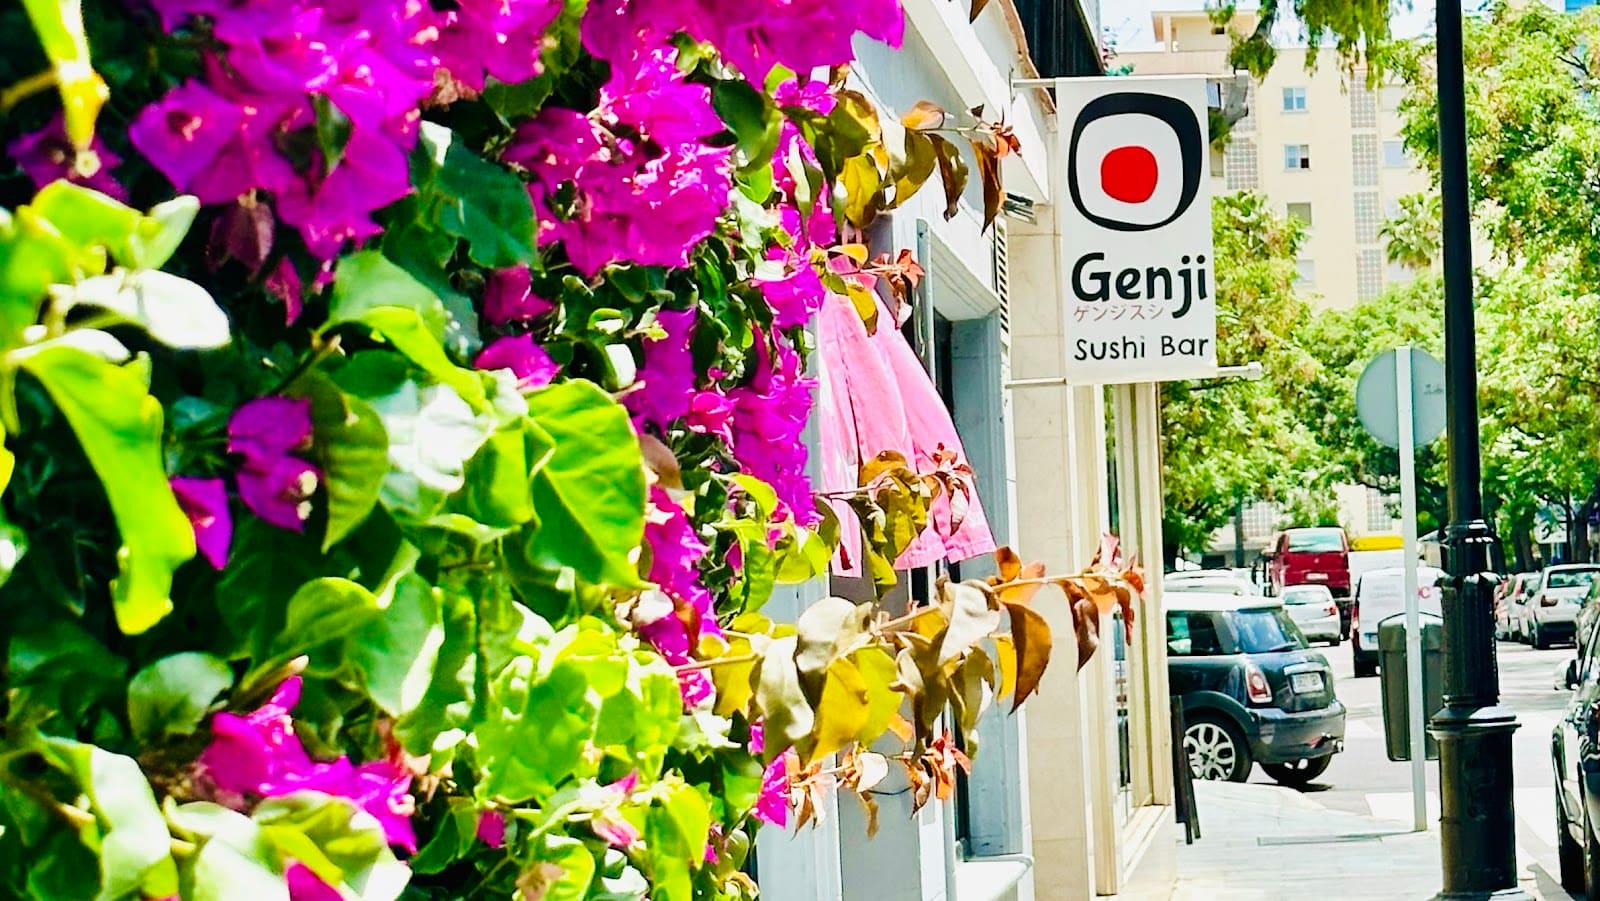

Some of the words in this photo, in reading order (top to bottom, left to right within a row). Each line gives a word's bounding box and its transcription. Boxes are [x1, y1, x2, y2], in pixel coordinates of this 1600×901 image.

[1071, 252, 1208, 319] Genji
[1073, 304, 1165, 322] ゲンジスシ
[1074, 335, 1145, 361] Sushi
[1161, 335, 1209, 357] Bar
